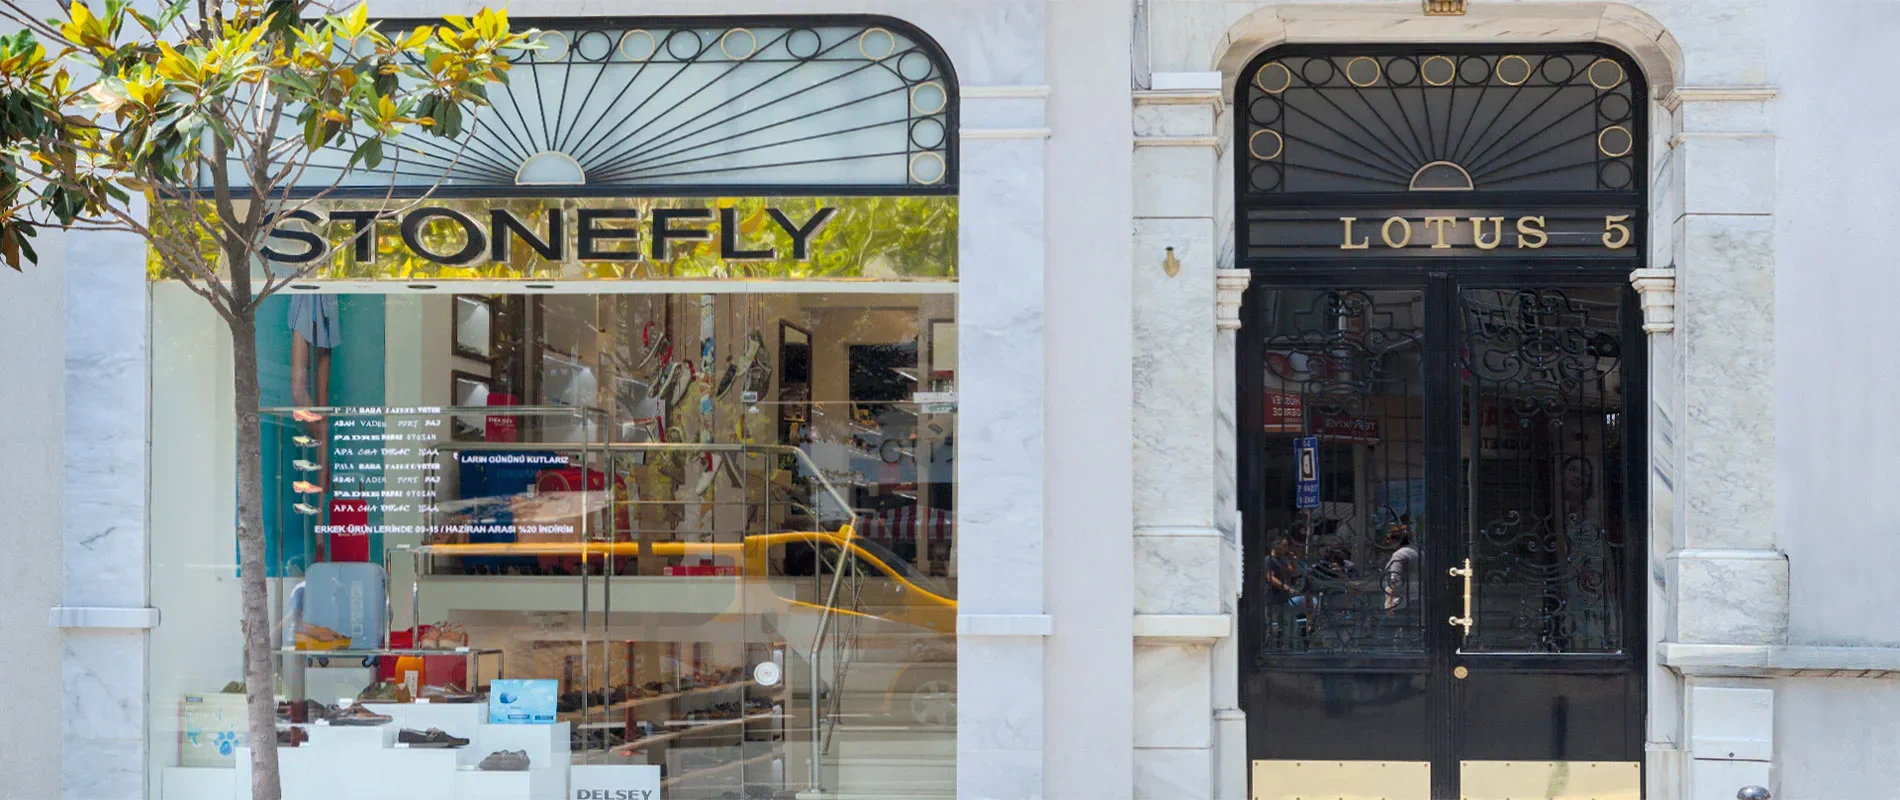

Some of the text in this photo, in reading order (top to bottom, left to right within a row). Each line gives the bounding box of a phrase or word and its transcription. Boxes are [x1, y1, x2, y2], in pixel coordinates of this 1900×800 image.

[259, 206, 838, 267] STONEFLY
[1340, 214, 1631, 250] LOTUS 5
[488, 453, 525, 464] GÜNÜNÜ
[526, 455, 569, 464] KUTLARIZ
[333, 504, 355, 513] APA
[314, 525, 346, 534] ERKEK
[445, 524, 486, 534] HAZİRAN
[487, 525, 516, 534] ARASI
[518, 525, 537, 534] %20
[538, 524, 574, 534] İNDİRİM
[576, 788, 653, 800] DELSEY
